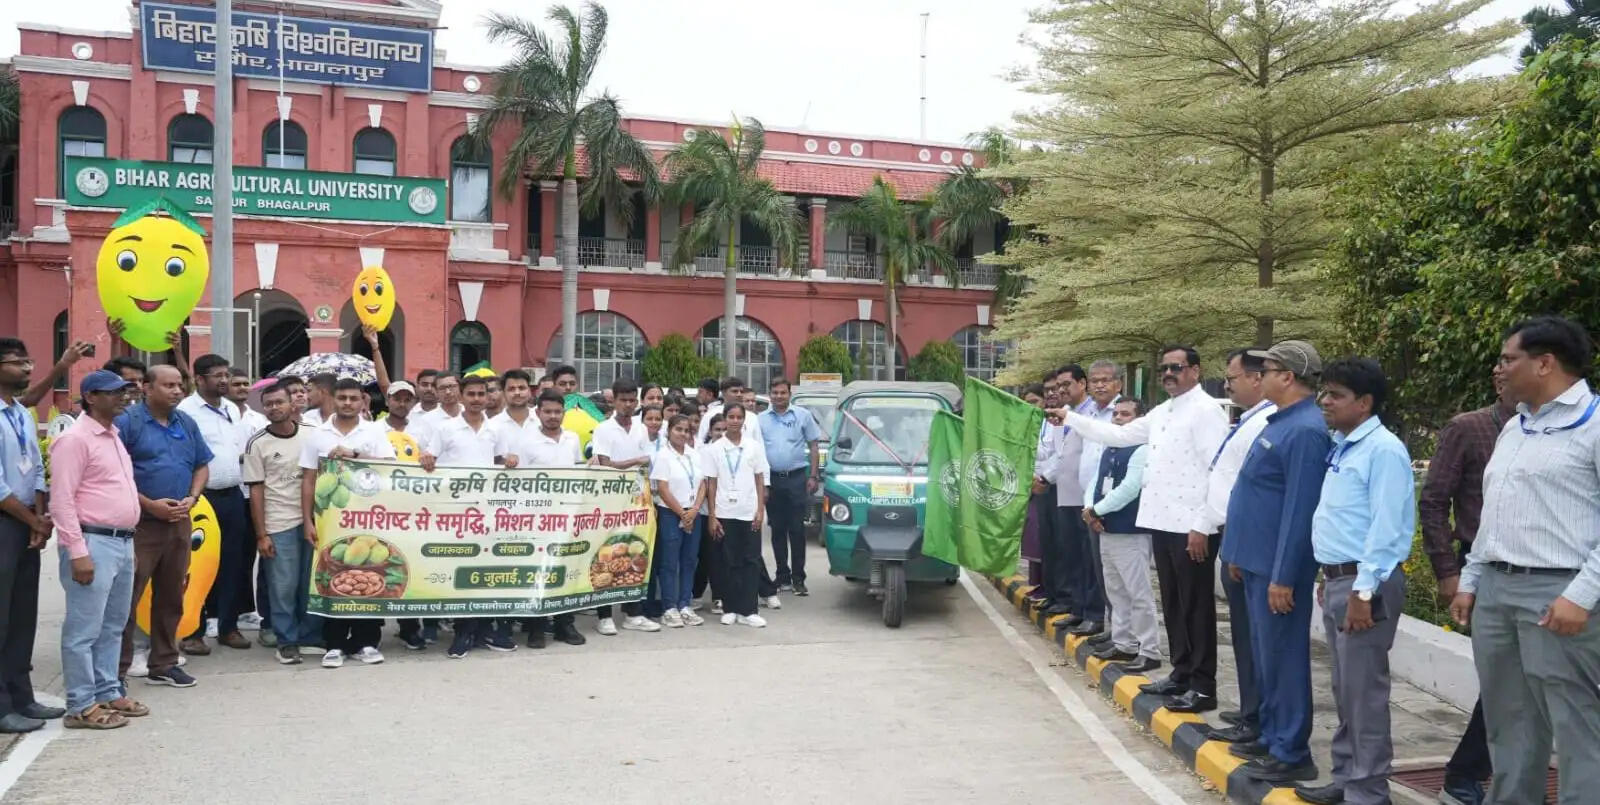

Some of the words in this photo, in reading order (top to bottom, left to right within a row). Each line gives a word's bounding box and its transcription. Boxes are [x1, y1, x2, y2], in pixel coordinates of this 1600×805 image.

[151, 10, 216, 44] बिहार
[274, 22, 423, 63] विश्वविद्यालय
[115, 167, 169, 188] BIHAR
[308, 175, 404, 201] UNIVERSITY
[195, 195, 247, 207] SAUR
[257, 198, 331, 212] BHAGALPUR
[390, 469, 443, 494] बिहार
[449, 472, 488, 498] कृषि
[493, 472, 600, 496] विश्वविद्यालय,
[602, 474, 635, 494] सबौर
[487, 499, 517, 509] भागलपुर
[339, 505, 411, 531] अपशिष्ट
[415, 507, 431, 531] से
[435, 507, 490, 538] समृद्धि,
[495, 508, 535, 532] मिशन
[538, 514, 568, 532] आम
[573, 508, 601, 537] गुठली
[470, 572, 480, 584] 6
[483, 568, 522, 587] जुलाई,
[526, 572, 558, 584] 2026
